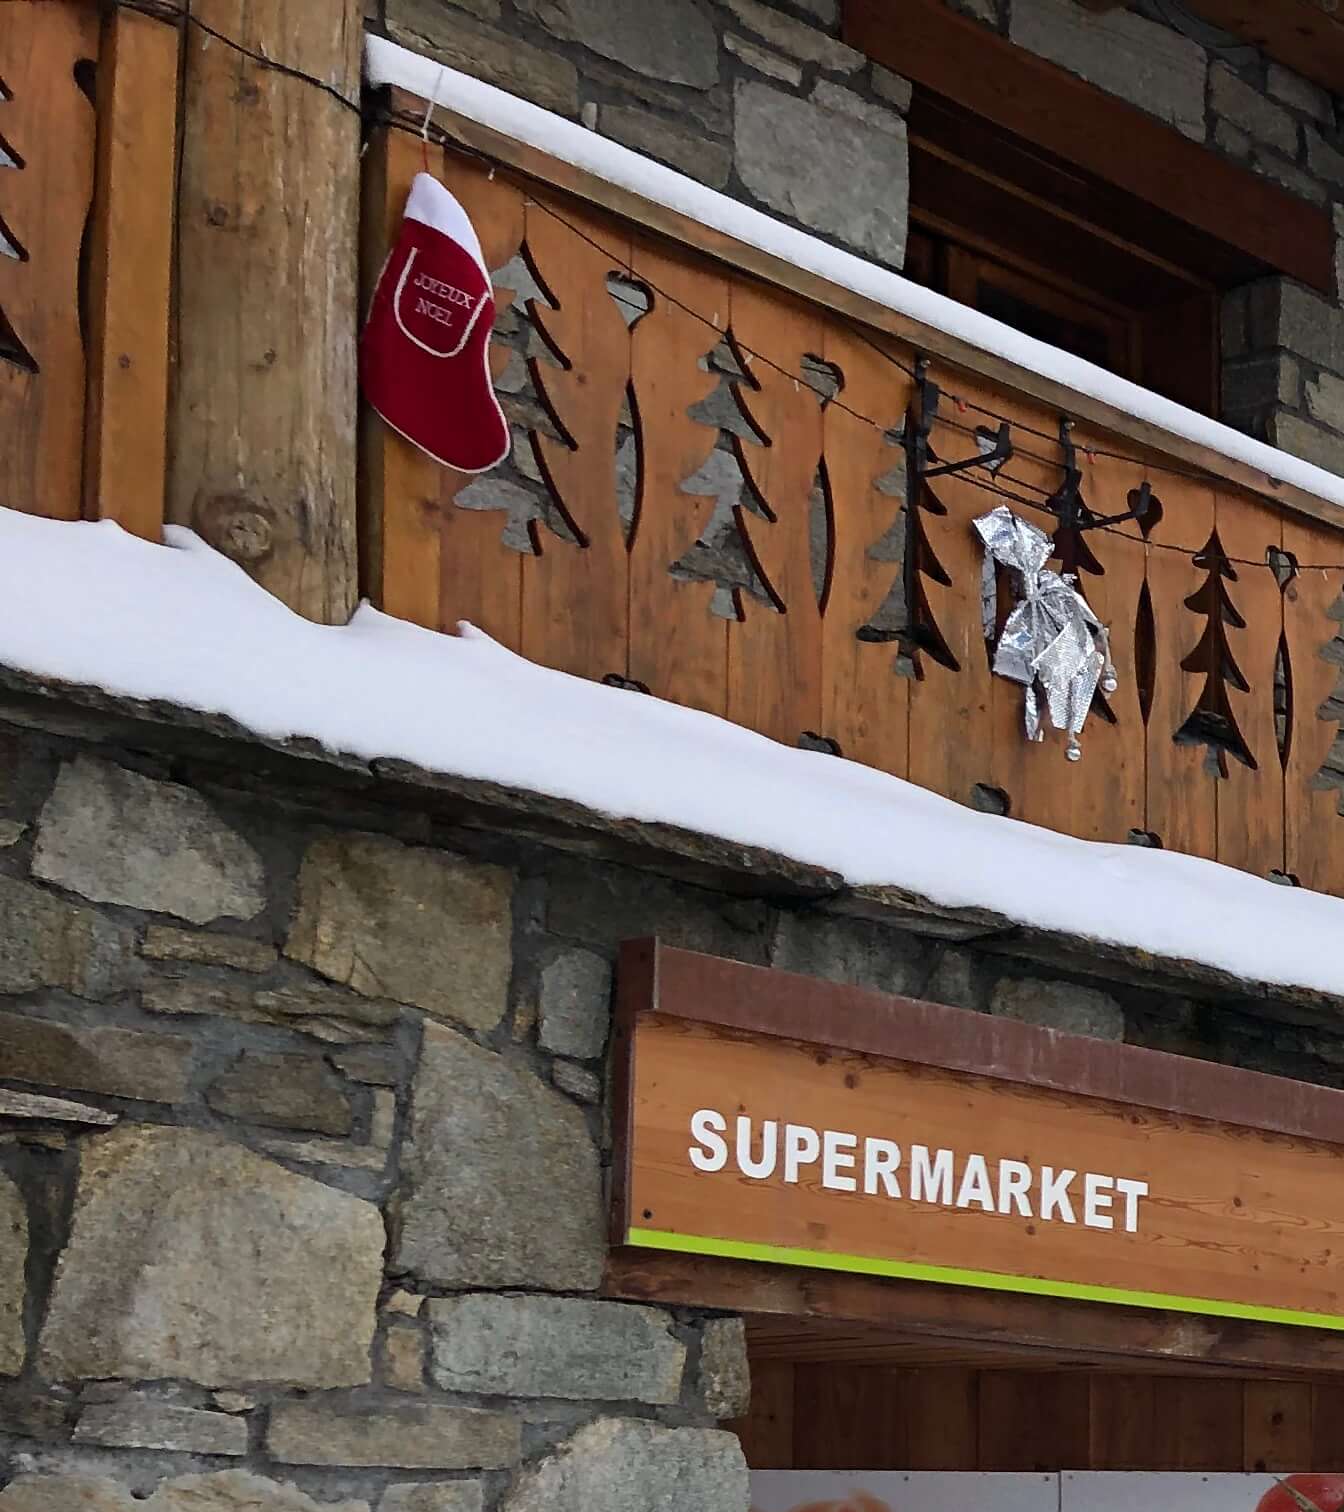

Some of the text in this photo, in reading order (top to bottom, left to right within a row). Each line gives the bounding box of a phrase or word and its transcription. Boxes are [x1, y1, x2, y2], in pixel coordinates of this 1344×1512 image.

[414, 272, 475, 309] JOYEUX
[415, 297, 453, 327] NOEL
[688, 1109, 1149, 1233] SUPERMARKET
